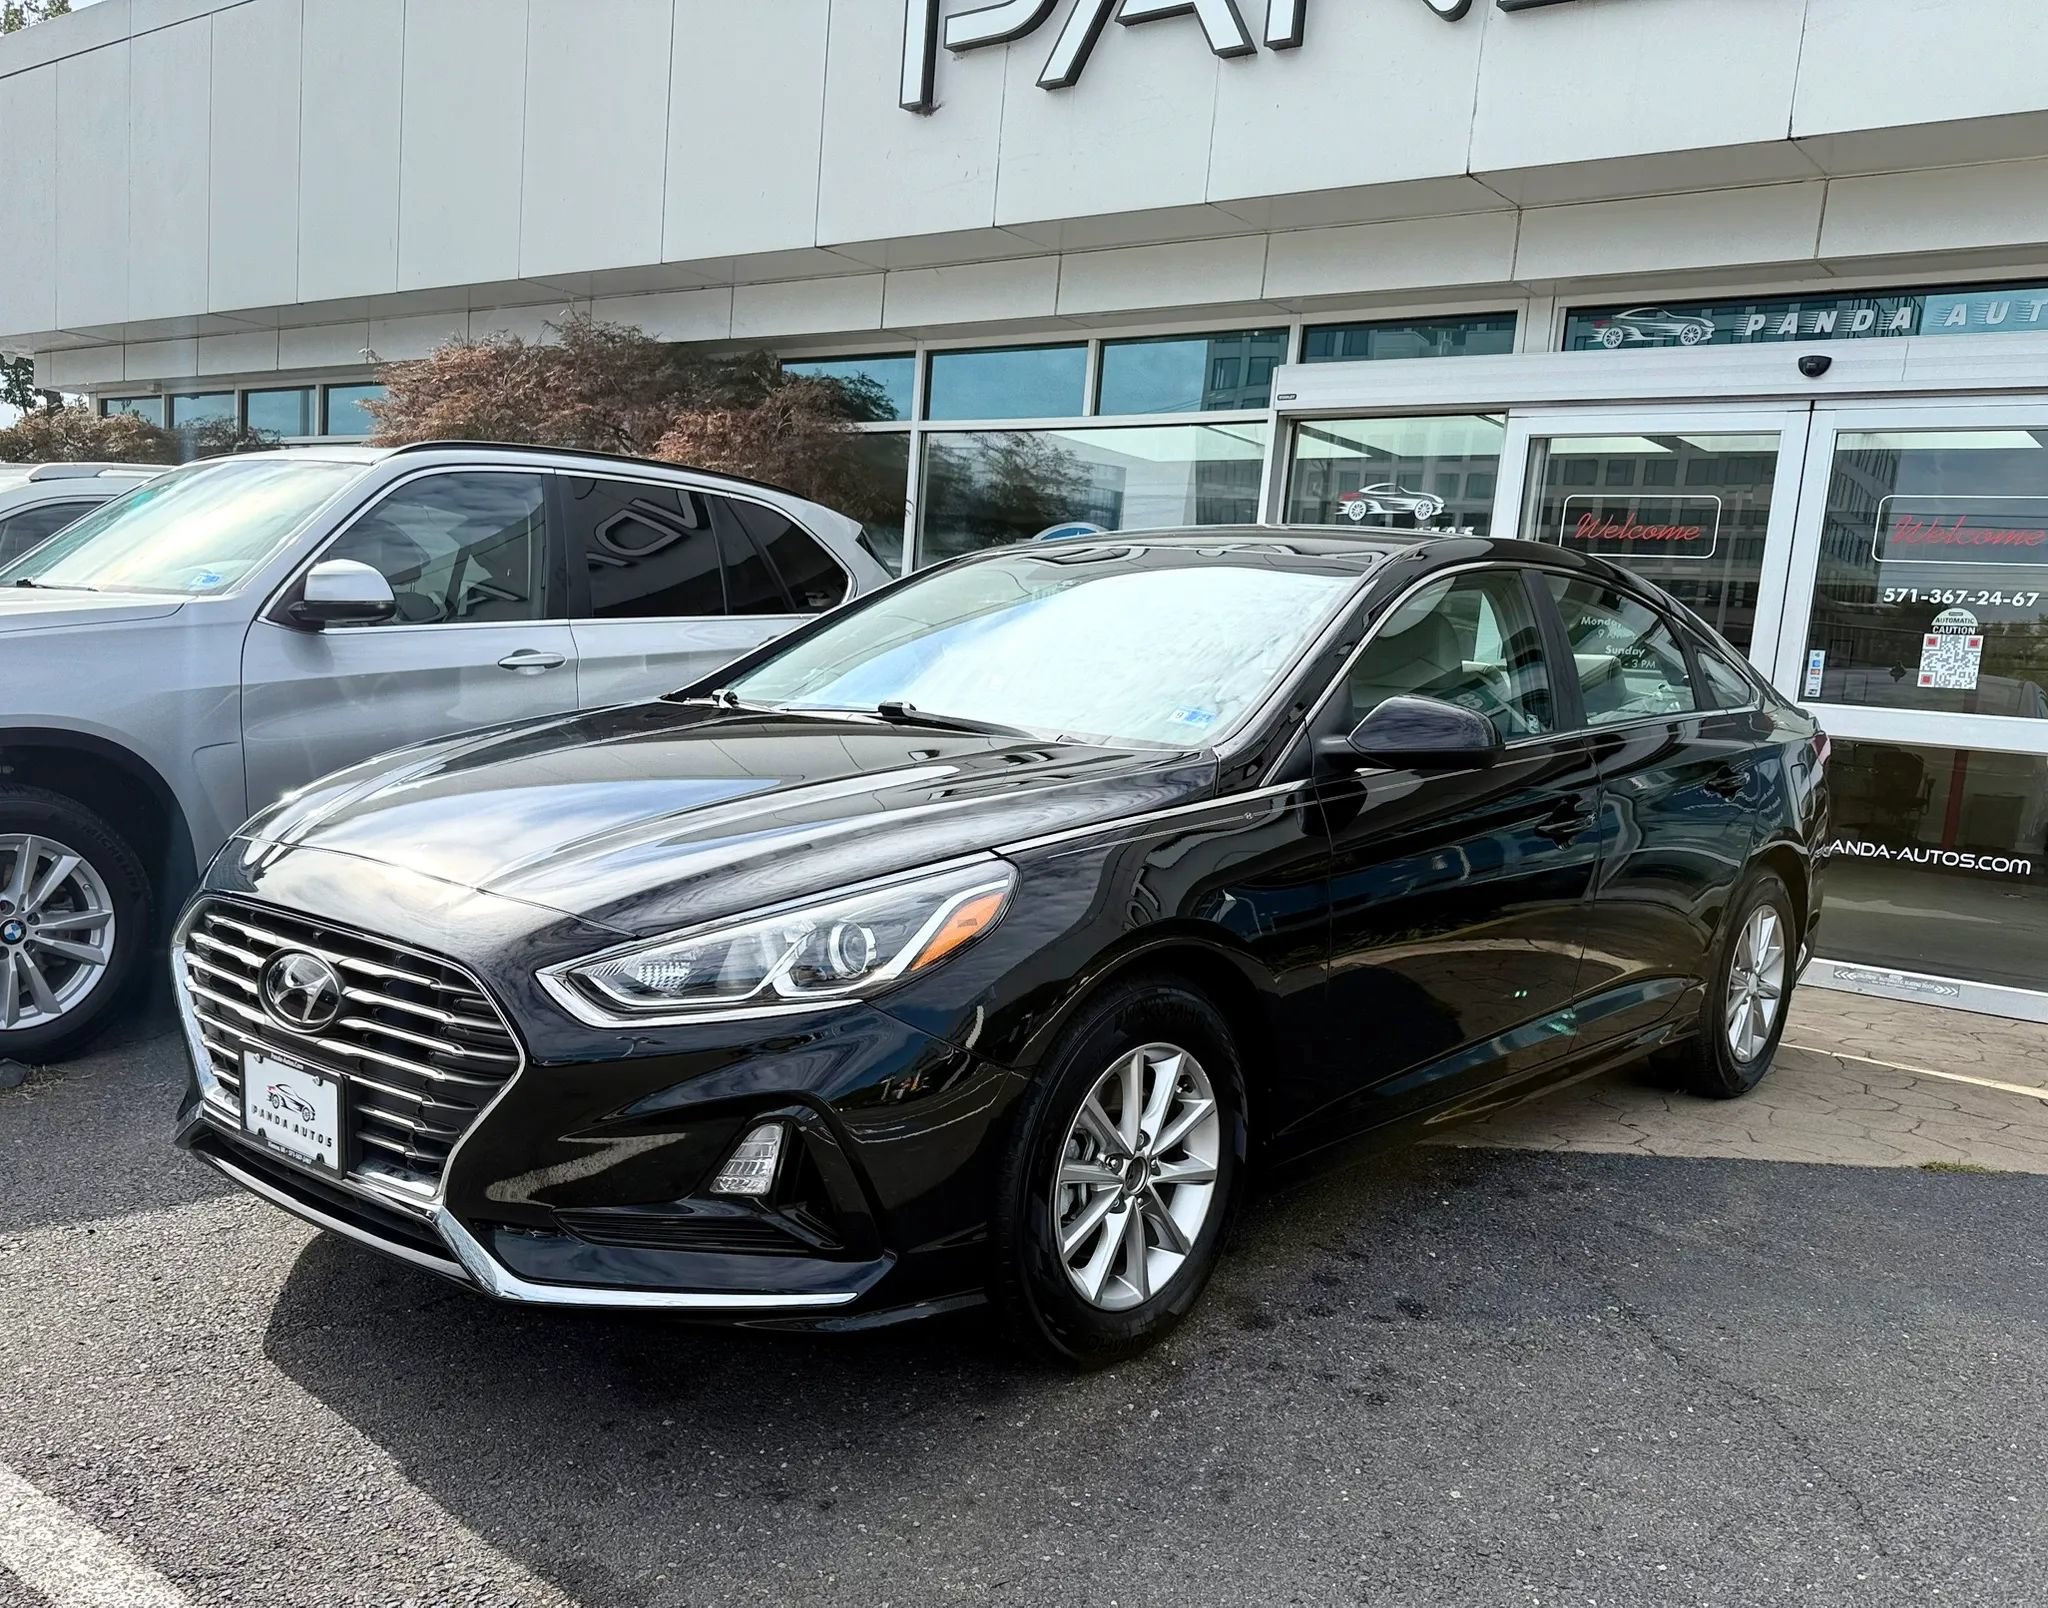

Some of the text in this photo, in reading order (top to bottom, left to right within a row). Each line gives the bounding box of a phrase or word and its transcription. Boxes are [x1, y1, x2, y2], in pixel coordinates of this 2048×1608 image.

[1734, 306, 1912, 336] PANDA
[1575, 512, 1701, 541] Welcome
[1892, 513, 2047, 546] Welcome
[1883, 587, 2040, 607] 571-367-24-67
[1932, 626, 1976, 635] CAUTION
[1605, 644, 1646, 658] Sunday
[1631, 659, 1638, 668] 3
[1641, 659, 1656, 669] PM
[1829, 839, 2031, 875] ANDA-AUTOS.COM
[251, 1104, 332, 1148] PANDA AUTOS
